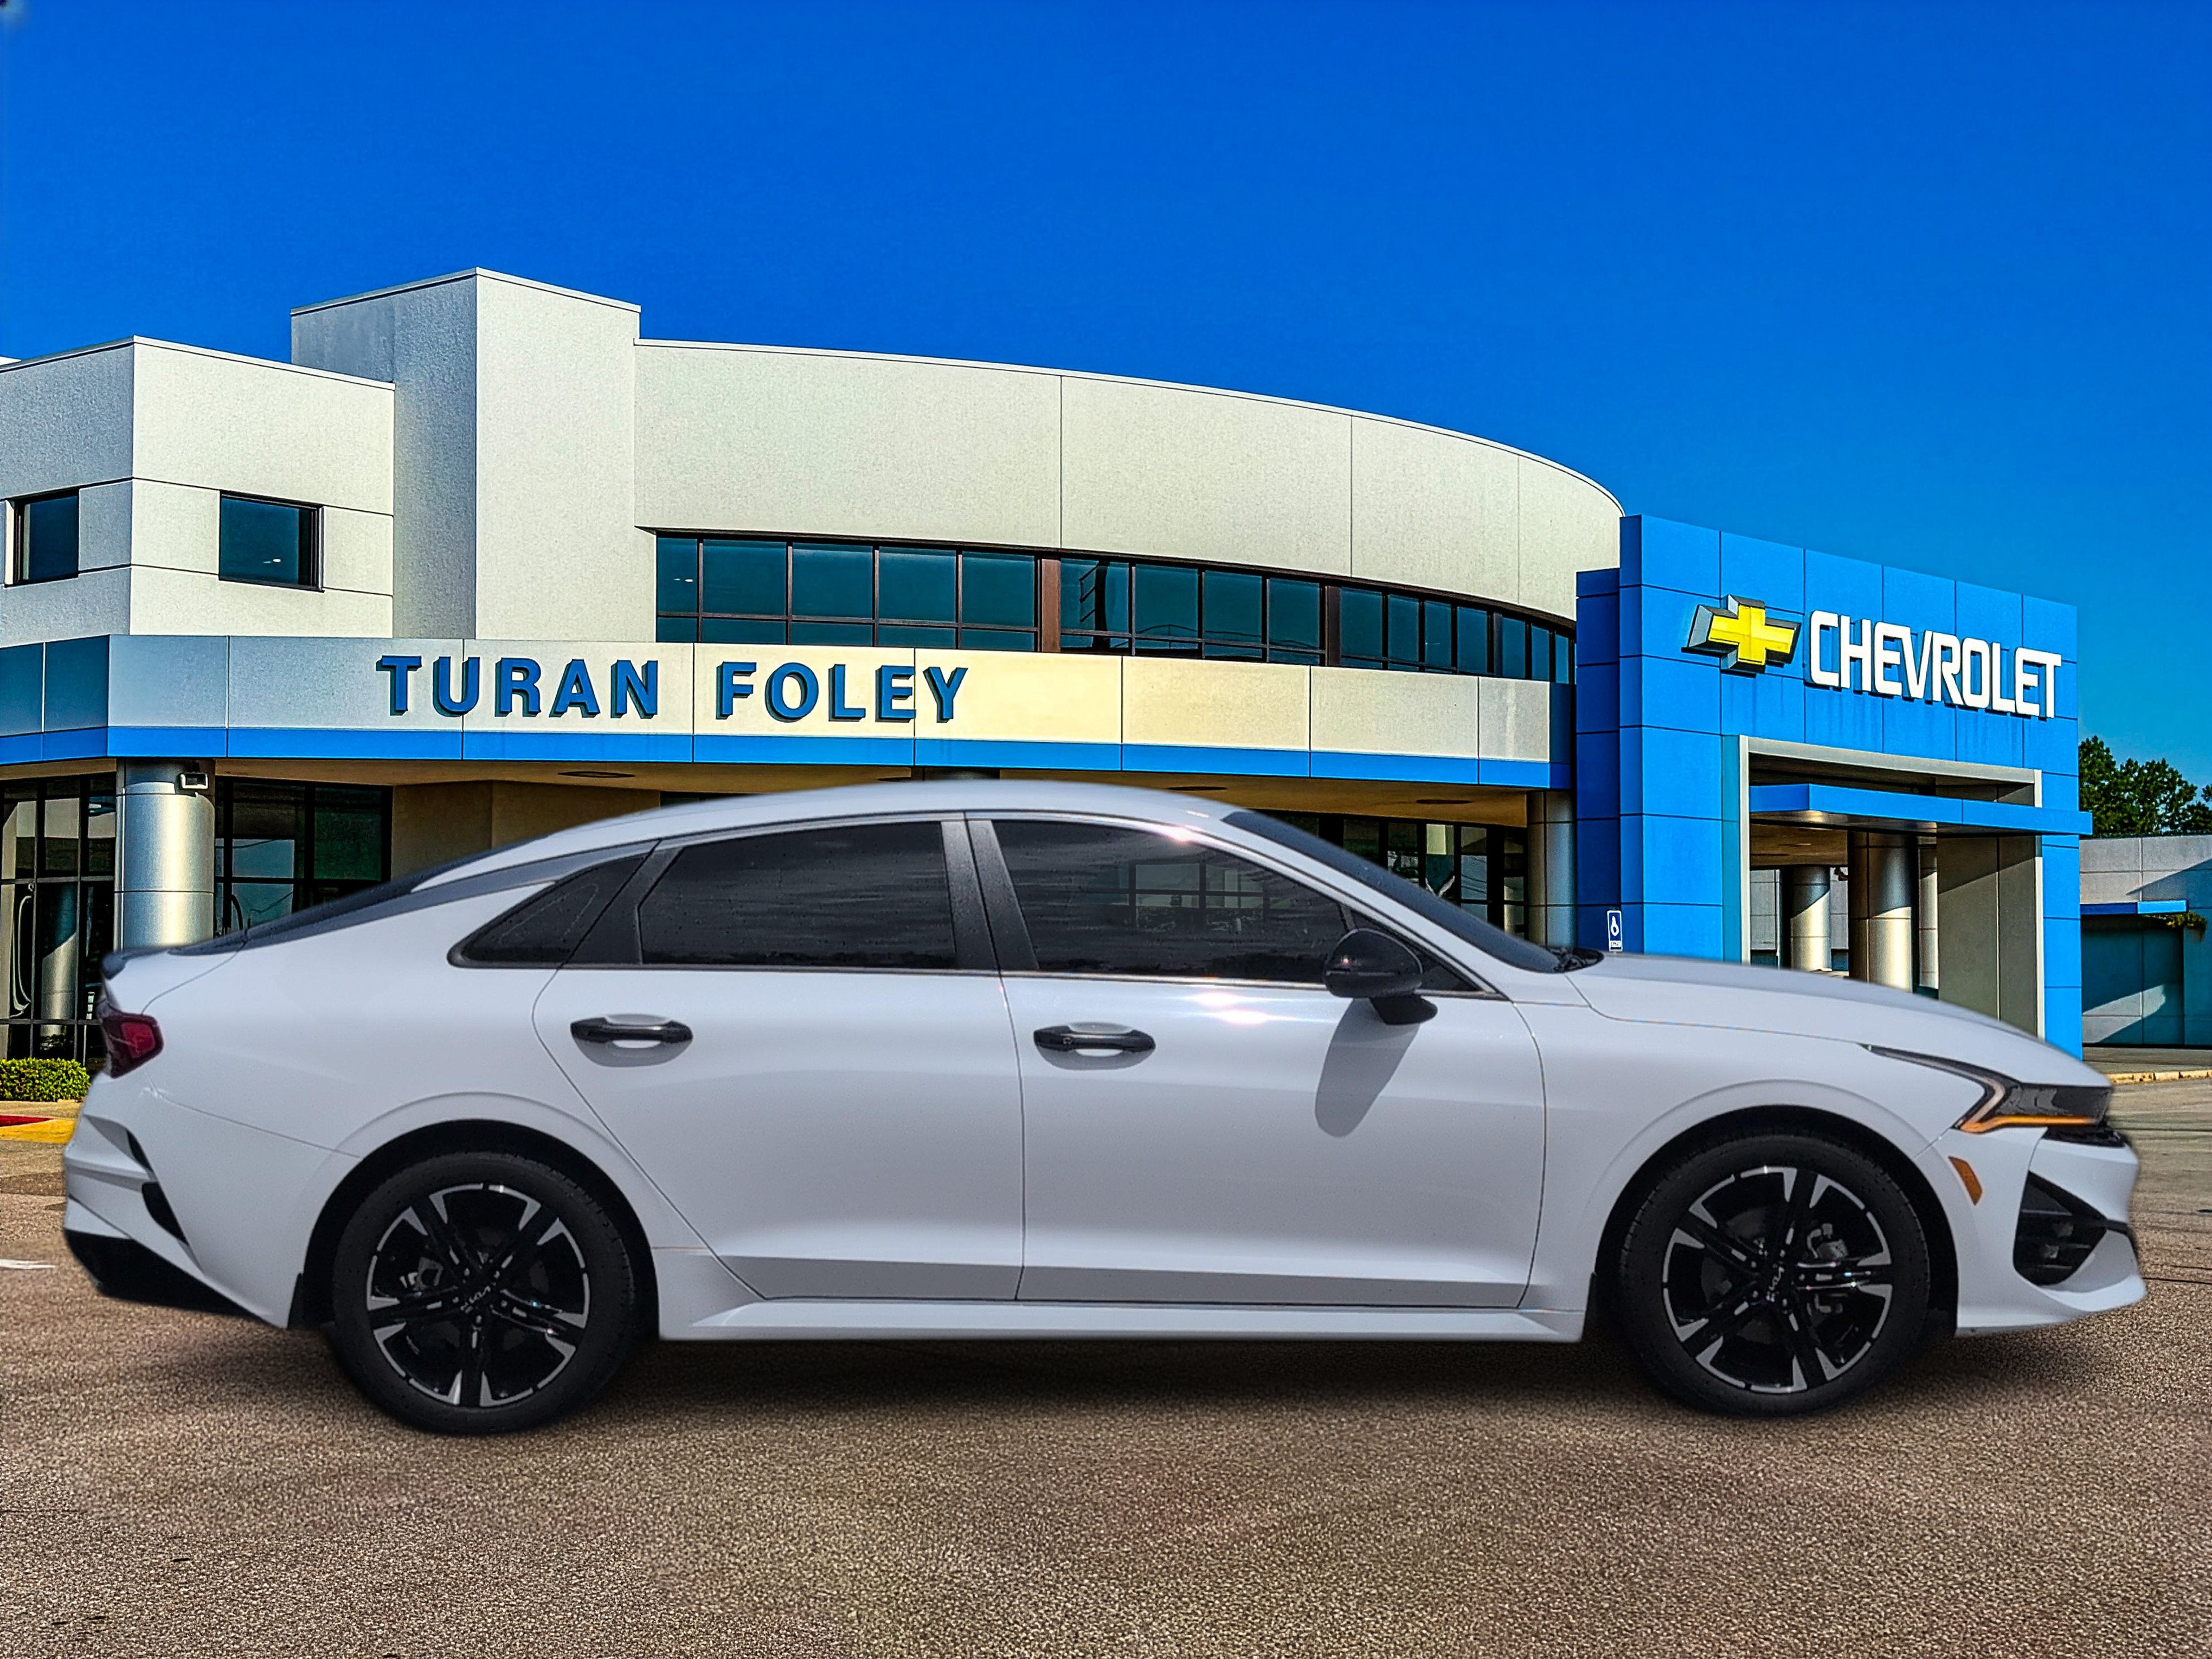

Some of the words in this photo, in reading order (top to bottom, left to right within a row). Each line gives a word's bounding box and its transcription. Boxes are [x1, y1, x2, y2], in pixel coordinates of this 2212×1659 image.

[376, 655, 658, 719] TURAN
[716, 661, 968, 723] FOLEY
[1809, 610, 2062, 718] CHEVROLET
